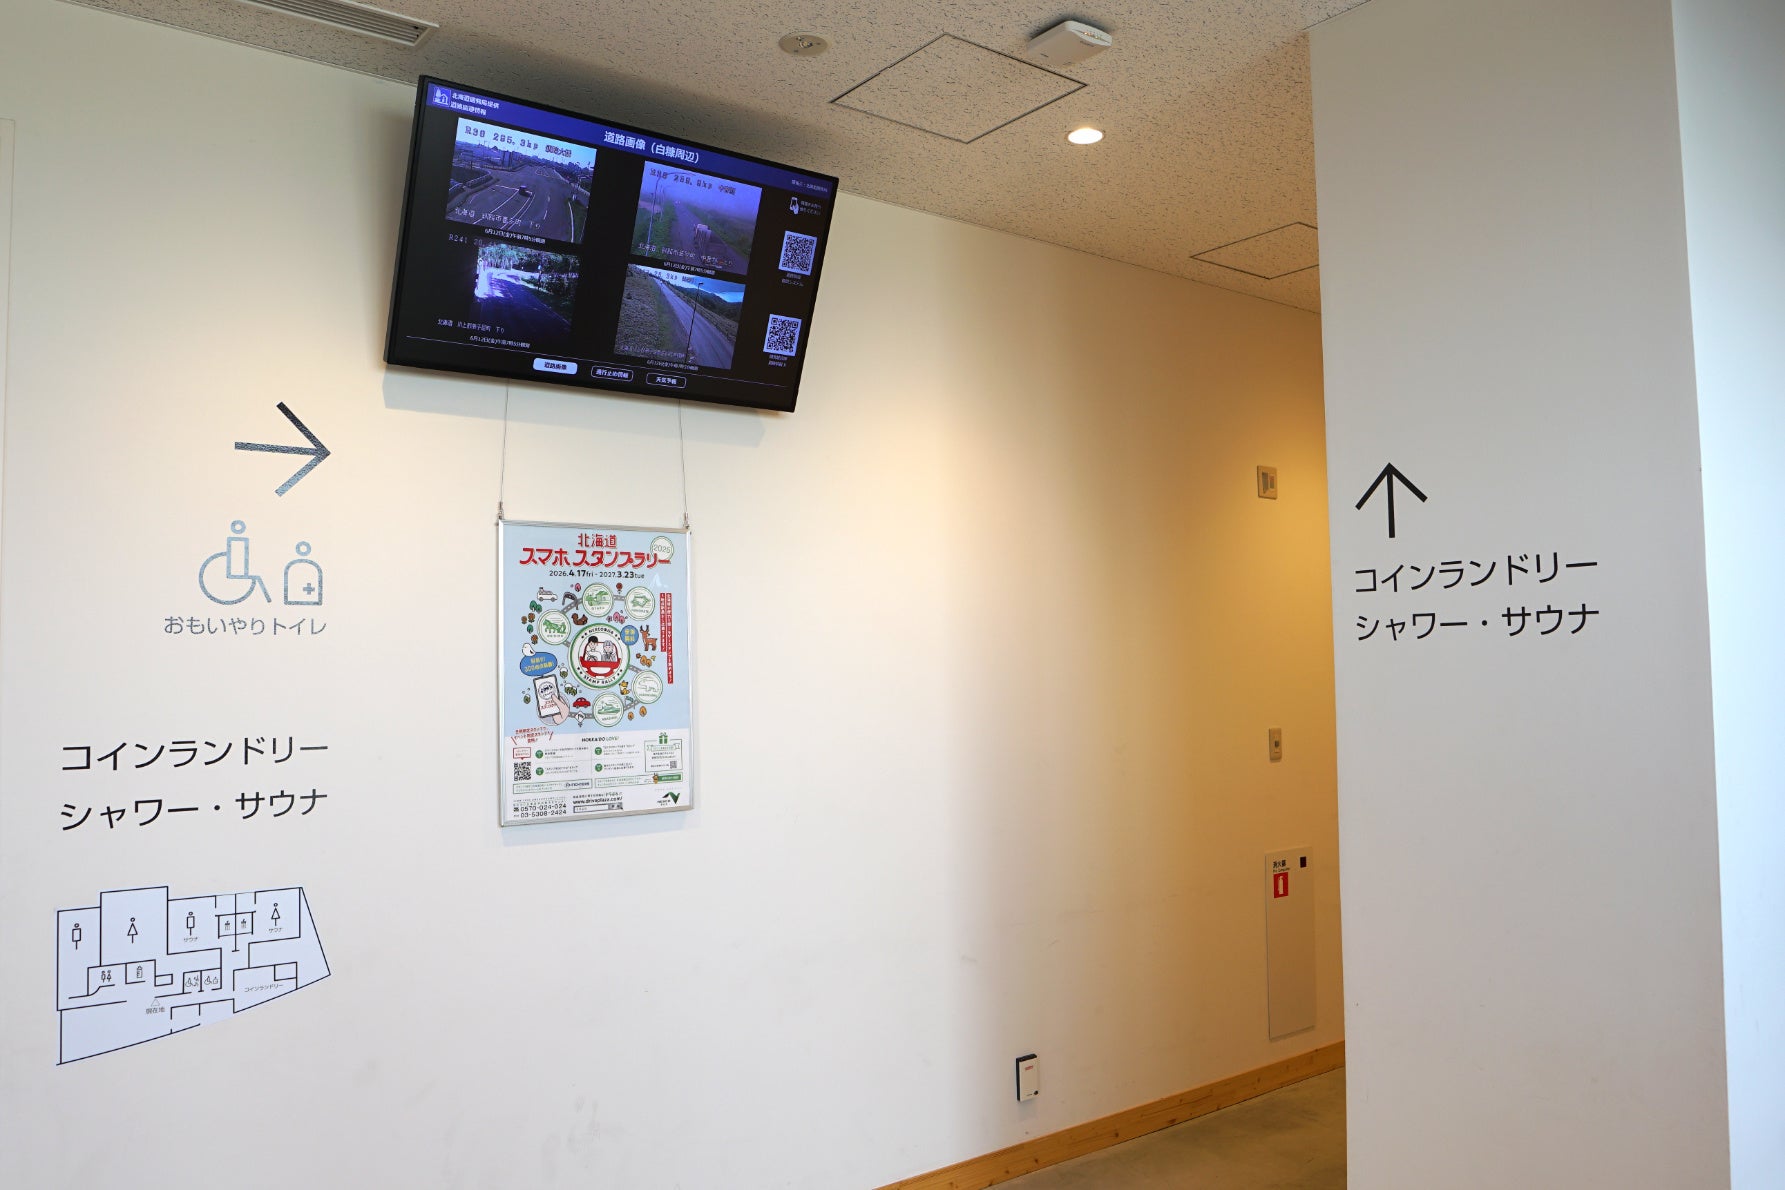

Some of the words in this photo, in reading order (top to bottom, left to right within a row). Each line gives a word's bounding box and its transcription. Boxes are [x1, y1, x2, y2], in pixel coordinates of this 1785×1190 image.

[577, 533, 617, 549] 北海道
[653, 543, 672, 554] 2025
[1355, 551, 1598, 593] コインランドリー
[164, 615, 328, 635] おもいやりトイレ
[1356, 603, 1600, 641] シャワー・サウナ
[62, 736, 329, 771] コインランドリー
[60, 788, 328, 831] シャワー・サウナ
